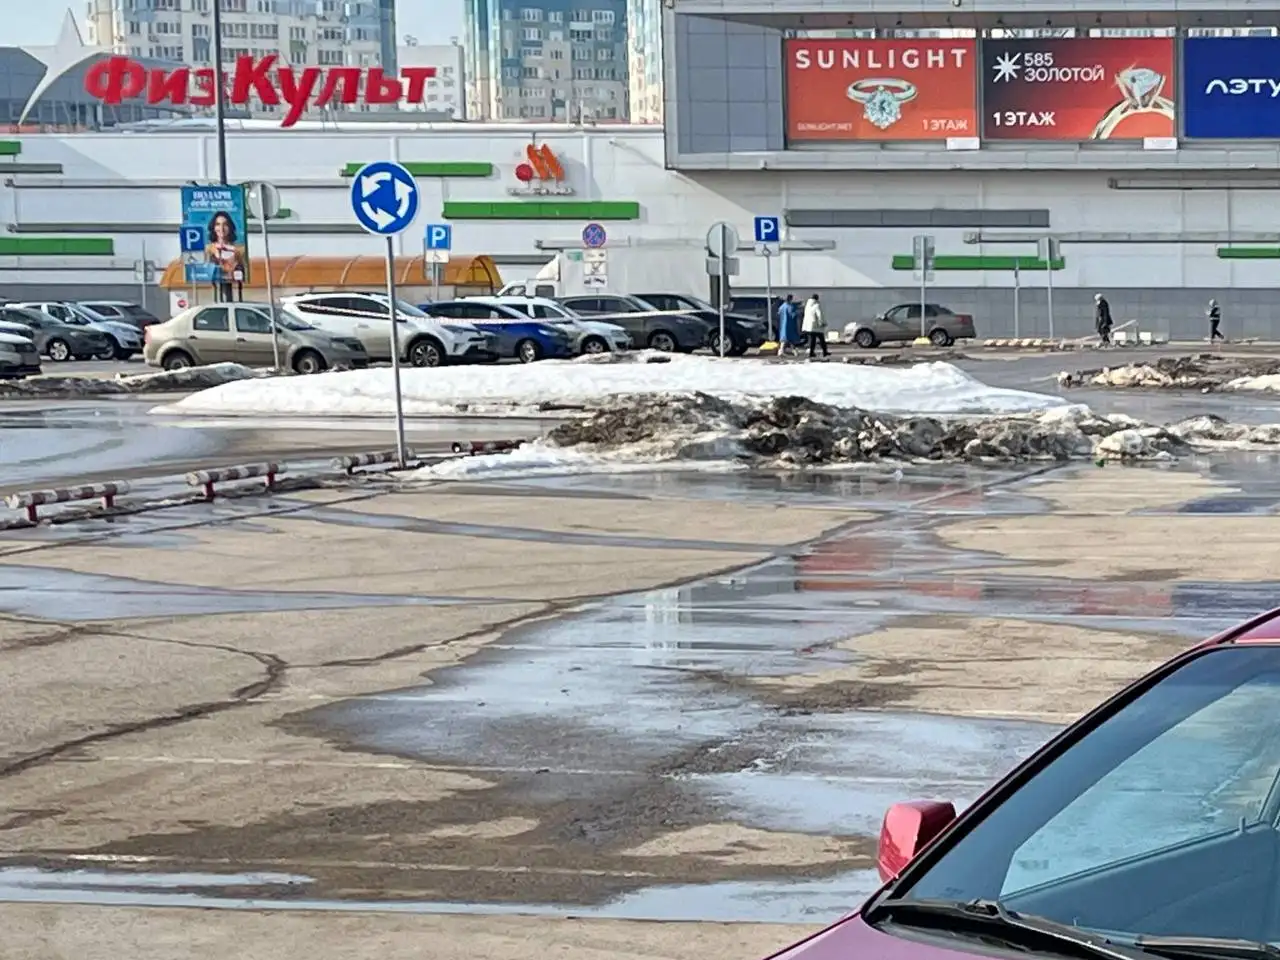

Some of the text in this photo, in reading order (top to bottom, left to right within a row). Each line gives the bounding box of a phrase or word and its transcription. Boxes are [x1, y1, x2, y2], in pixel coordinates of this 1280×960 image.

[796, 48, 967, 69] SUNLIGHT
[1024, 52, 1053, 67] 585
[1024, 64, 1105, 82] ЗОЛОТОЙ
[84, 52, 437, 128] ФизКульт
[922, 119, 968, 131] 1 ЭТАЖ
[993, 111, 1056, 127] 1 ЭТАЖ
